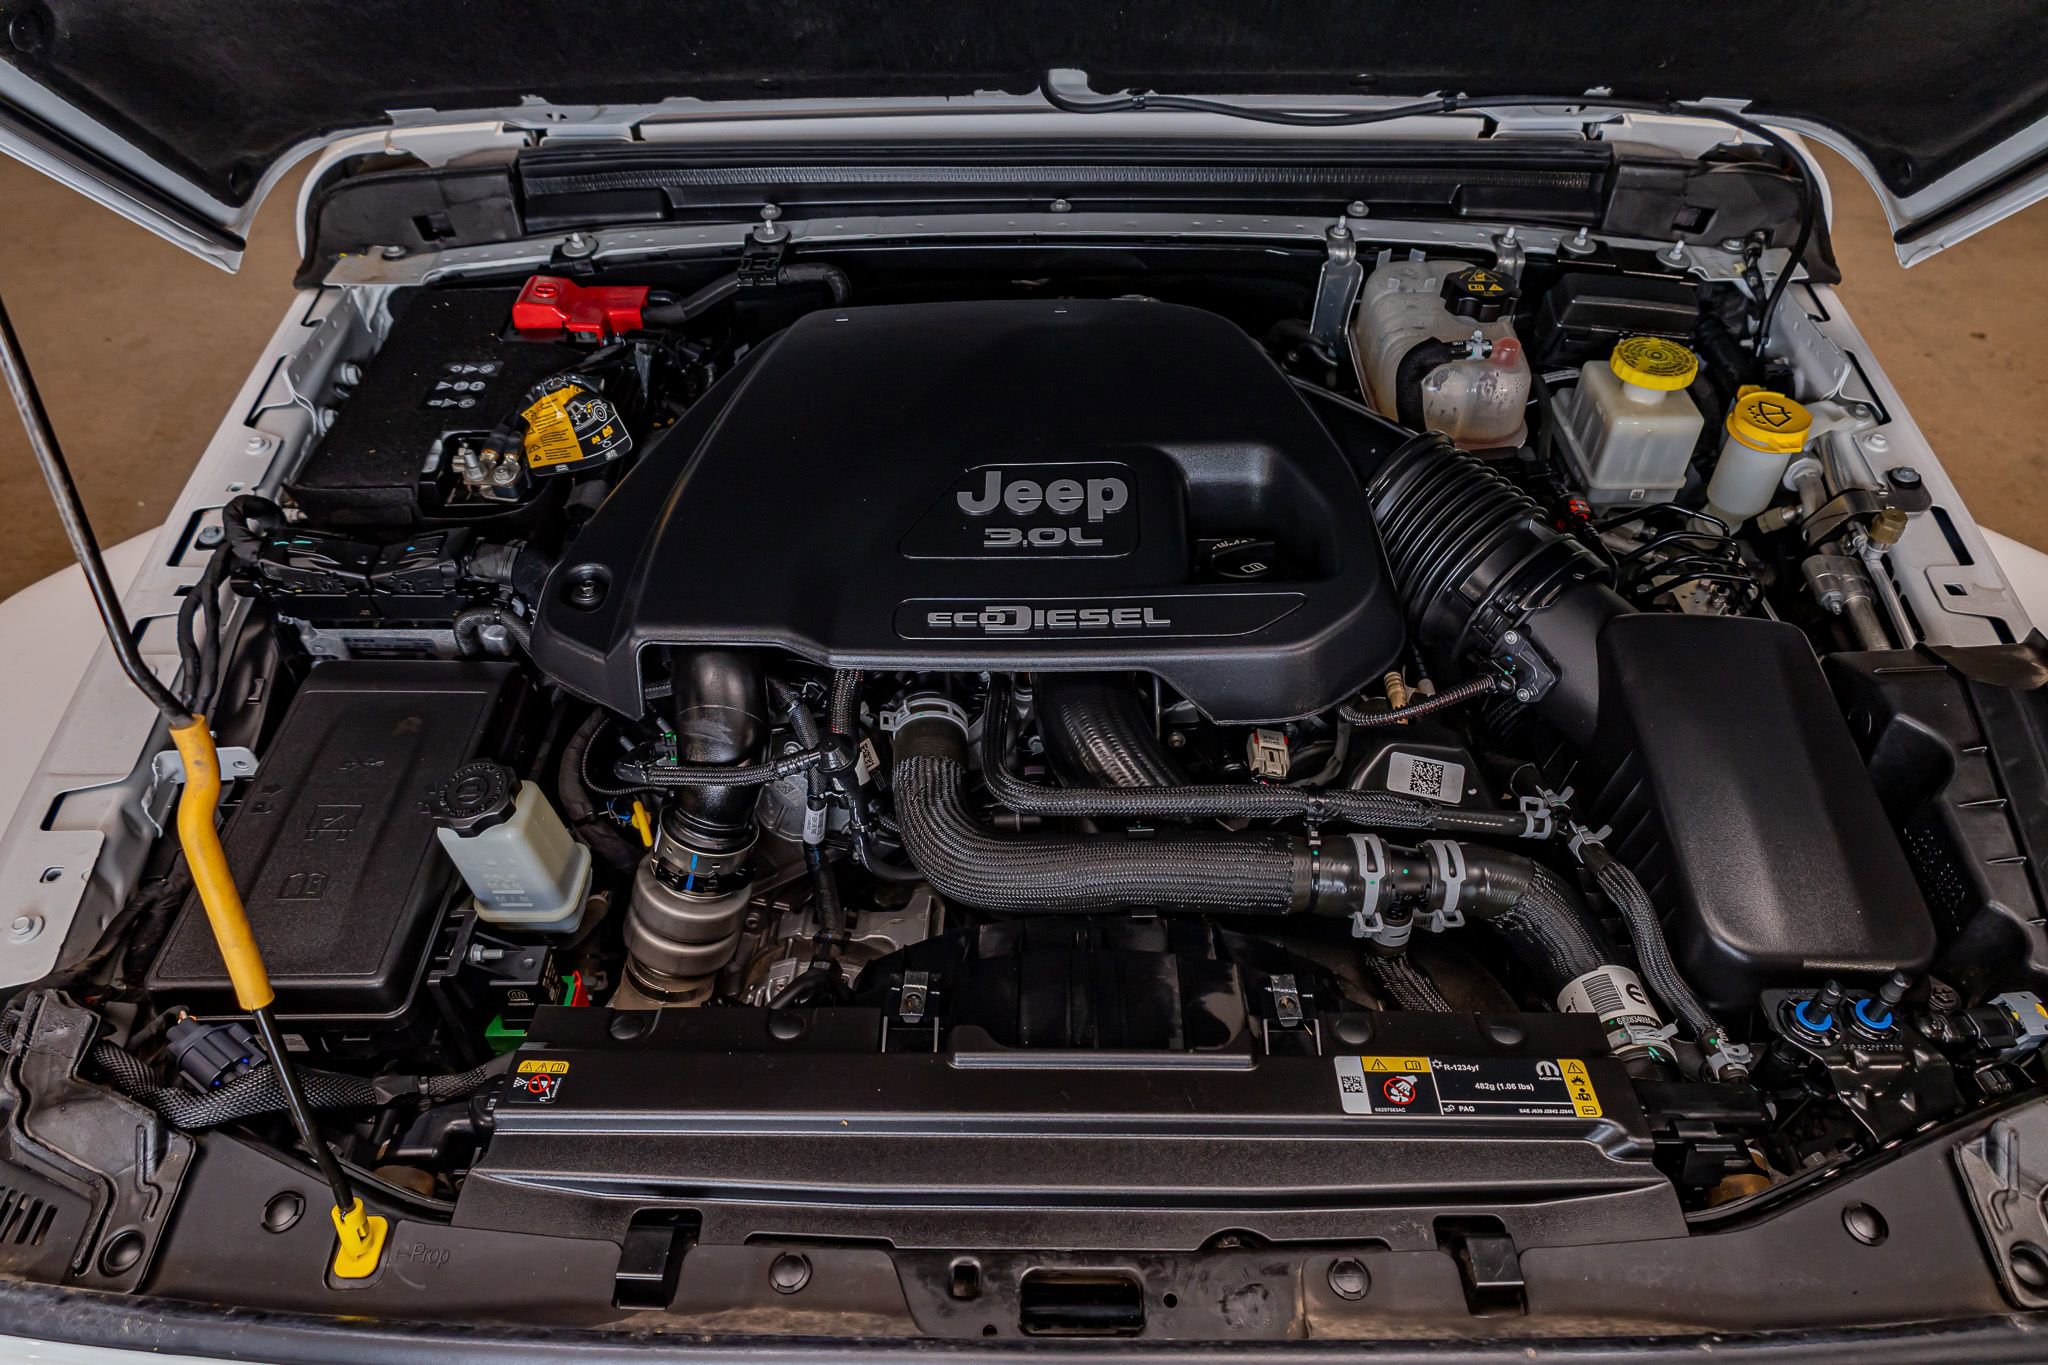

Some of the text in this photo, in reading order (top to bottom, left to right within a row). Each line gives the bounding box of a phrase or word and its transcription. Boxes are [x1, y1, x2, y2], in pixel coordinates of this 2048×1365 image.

[957, 470, 1128, 522] Jeep
[984, 527, 1103, 547] 3.0L
[1444, 1064, 1479, 1073] R-1234yf
[1475, 1082, 1535, 1092] 482g (1.06 lbs)
[411, 1242, 451, 1270] Prop
